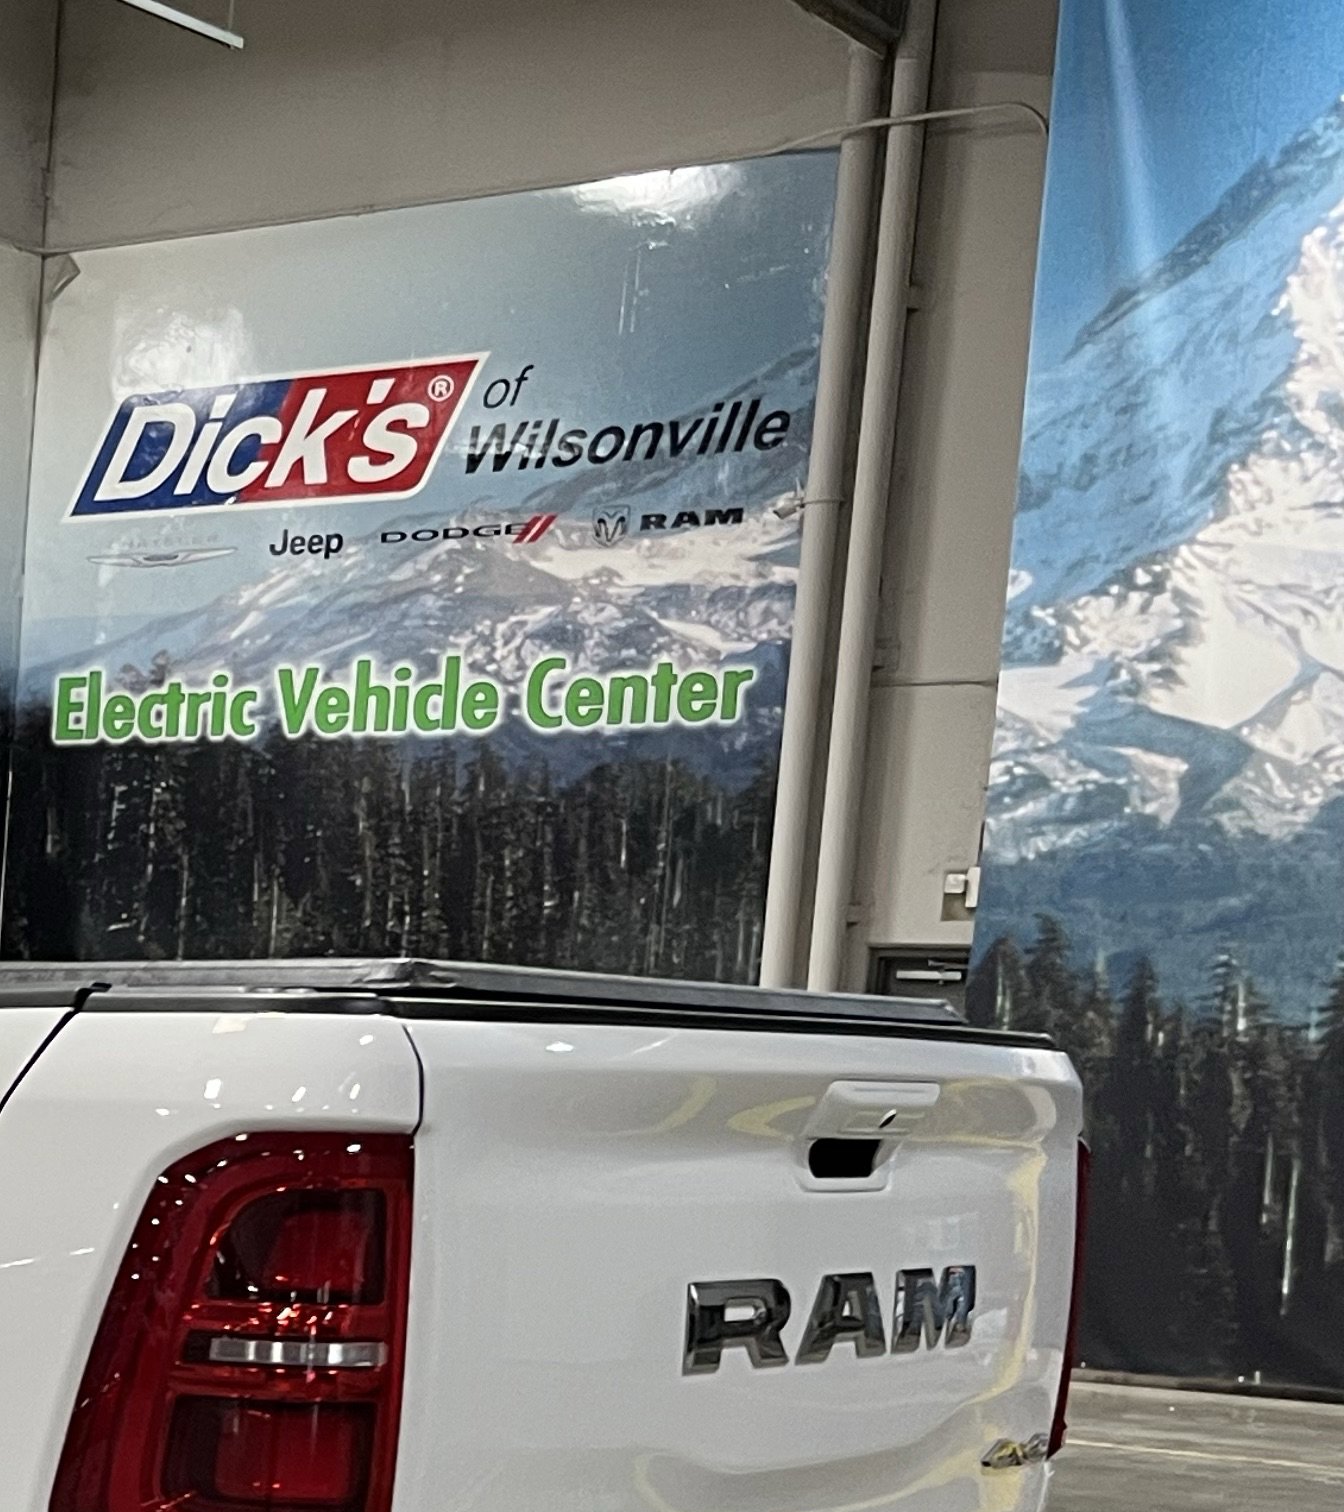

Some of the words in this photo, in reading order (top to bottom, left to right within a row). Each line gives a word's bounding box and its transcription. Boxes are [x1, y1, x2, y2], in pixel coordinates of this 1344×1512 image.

[93, 378, 430, 502] Dick's
[483, 364, 535, 409] of
[465, 399, 791, 475] Wilsonville
[269, 529, 344, 559] Jeep
[380, 522, 527, 544] DODGE
[639, 507, 745, 532] RAM
[55, 670, 258, 740] Electric
[278, 656, 499, 734] Vehicle
[526, 657, 754, 729] Center
[681, 1264, 976, 1377] RAM
